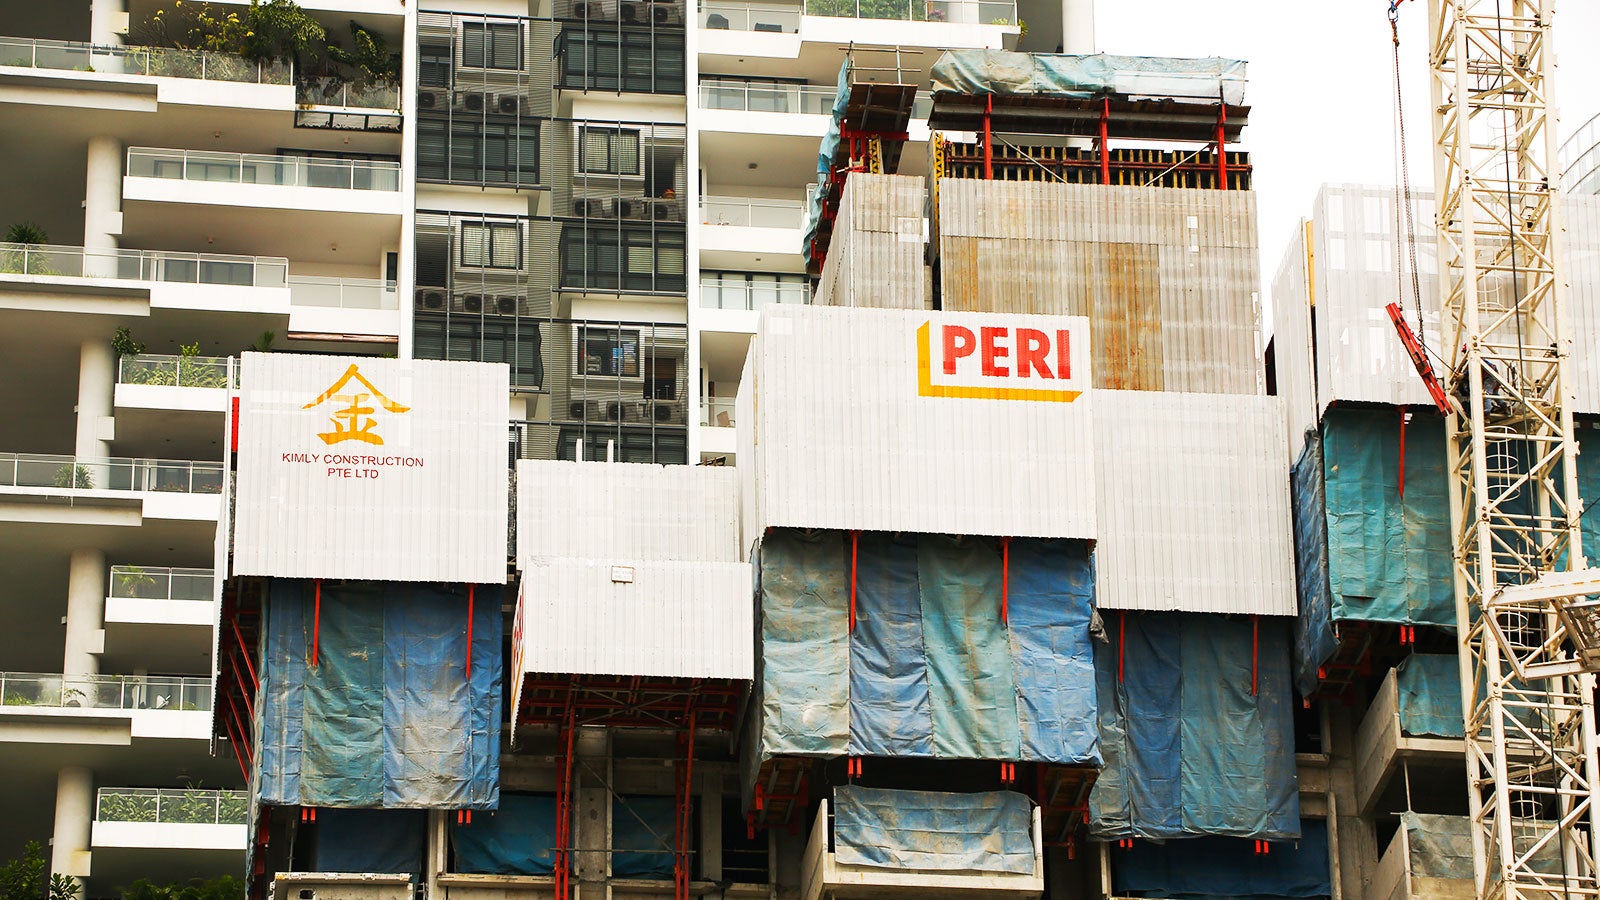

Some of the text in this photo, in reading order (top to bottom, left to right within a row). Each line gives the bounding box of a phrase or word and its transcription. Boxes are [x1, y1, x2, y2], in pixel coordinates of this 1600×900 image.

[942, 325, 1071, 380] PERI
[301, 363, 411, 446] 金
[282, 453, 425, 467] KIMLY CONSTRUCTION
[327, 467, 379, 479] PTE LTD
